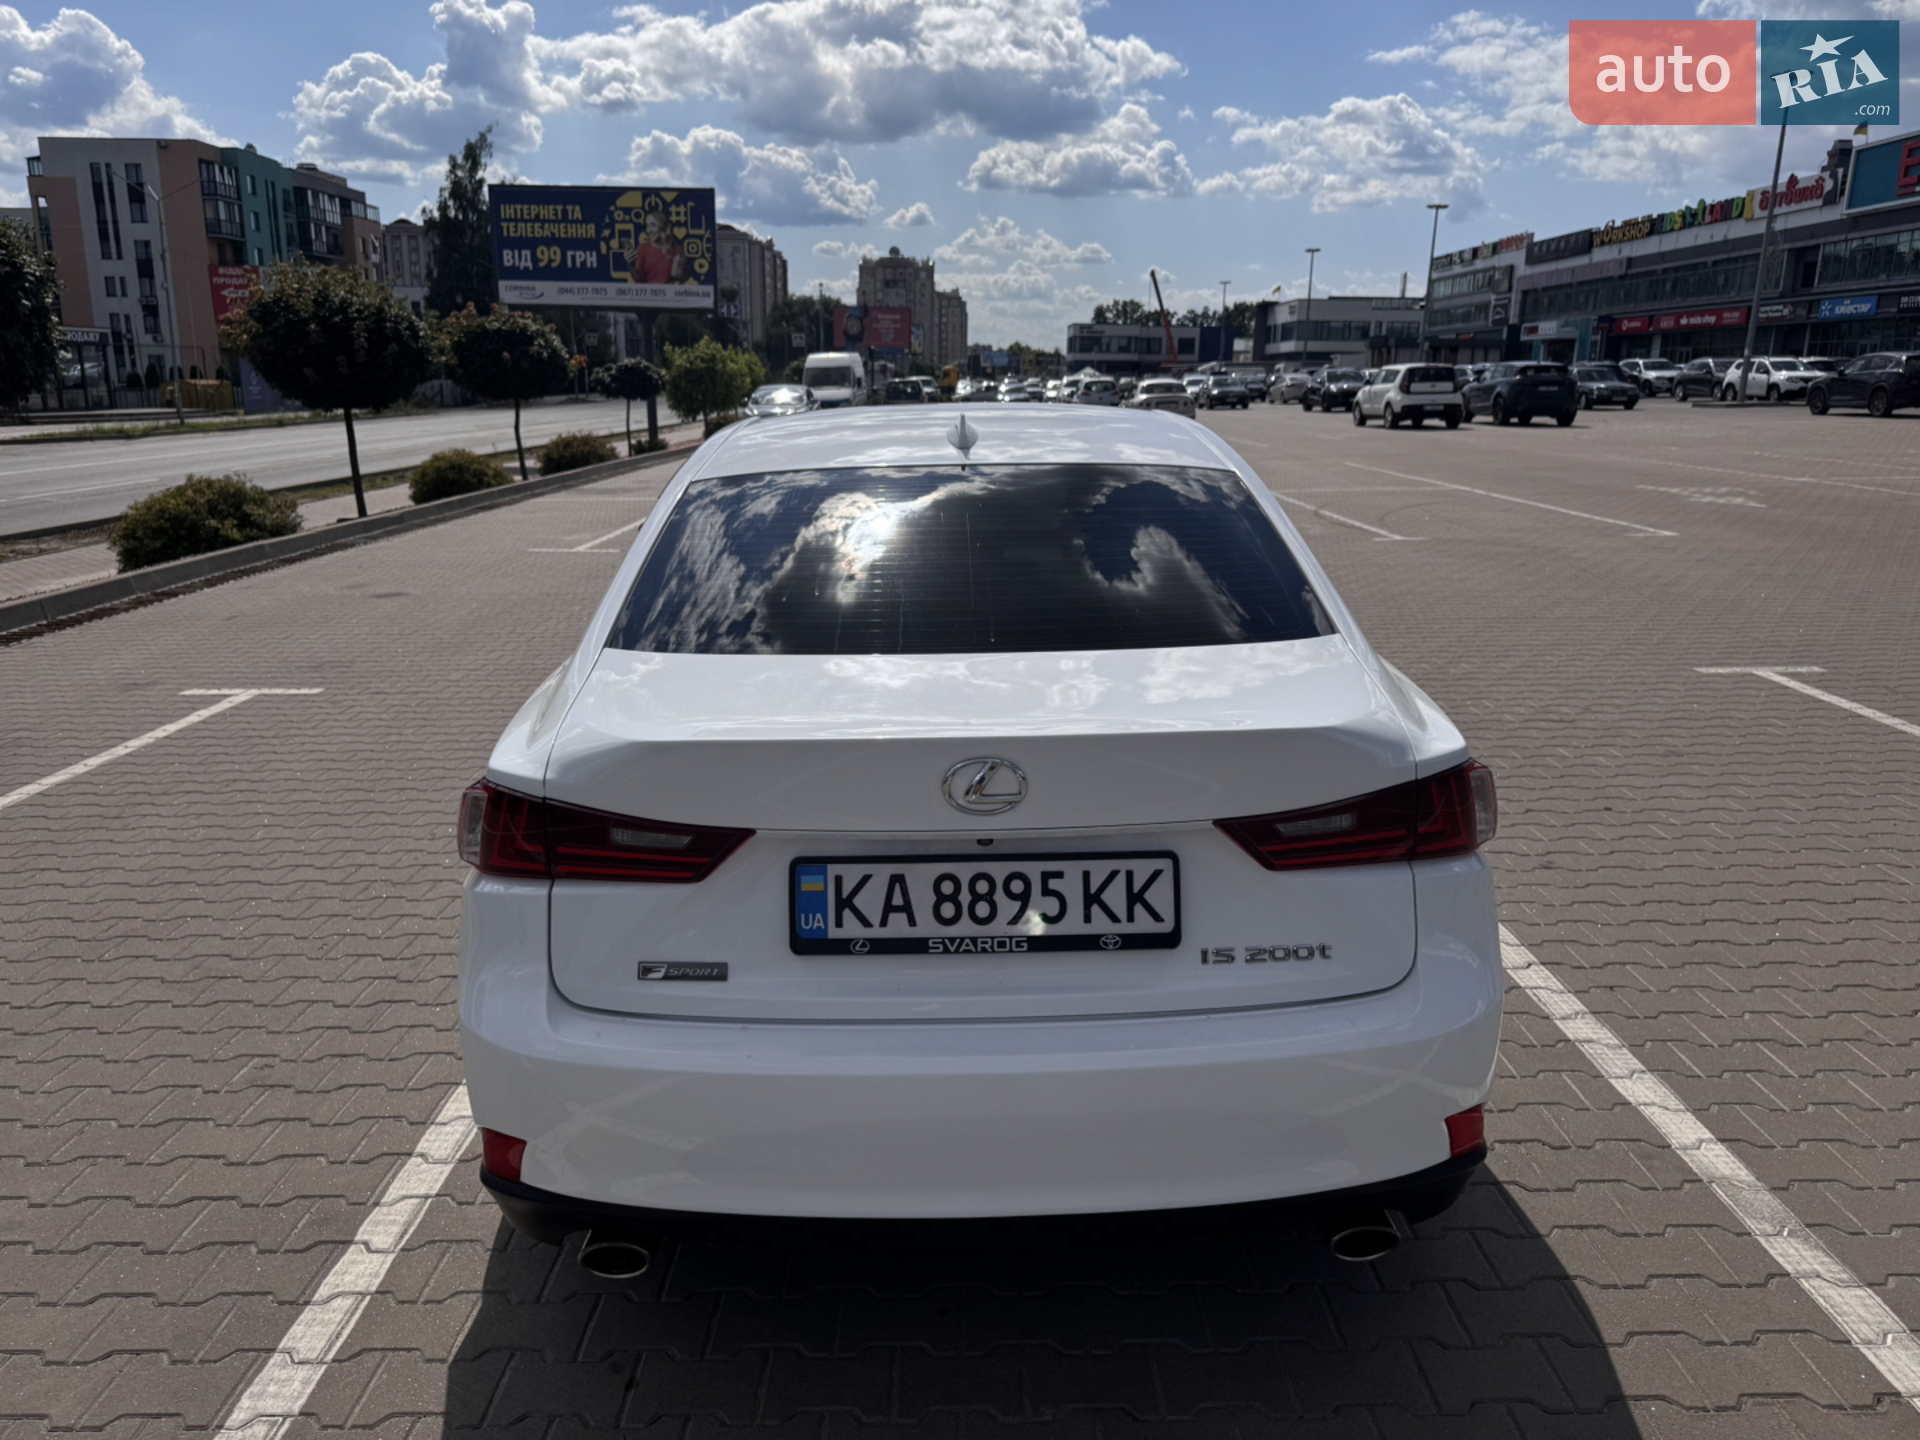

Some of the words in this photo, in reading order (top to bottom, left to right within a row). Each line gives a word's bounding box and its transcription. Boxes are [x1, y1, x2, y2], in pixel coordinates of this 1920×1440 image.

[500, 204, 563, 220] ІНТЕРНЕТ
[566, 205, 582, 220] ТА
[501, 222, 596, 238] ТЕЛЕБАЧЕННЯ
[1593, 219, 1652, 247] WORKSHOP
[503, 249, 533, 271] ВІД
[536, 245, 562, 268] 99
[567, 250, 597, 269] ГРН
[834, 873, 917, 928] KA
[932, 870, 1067, 927] 8895
[1082, 868, 1165, 925] KK
[801, 912, 825, 930] UA
[928, 937, 1028, 953] SVAROG
[1201, 947, 1236, 965] IS
[1244, 943, 1332, 964] 200t
[668, 967, 721, 977] SPORT
